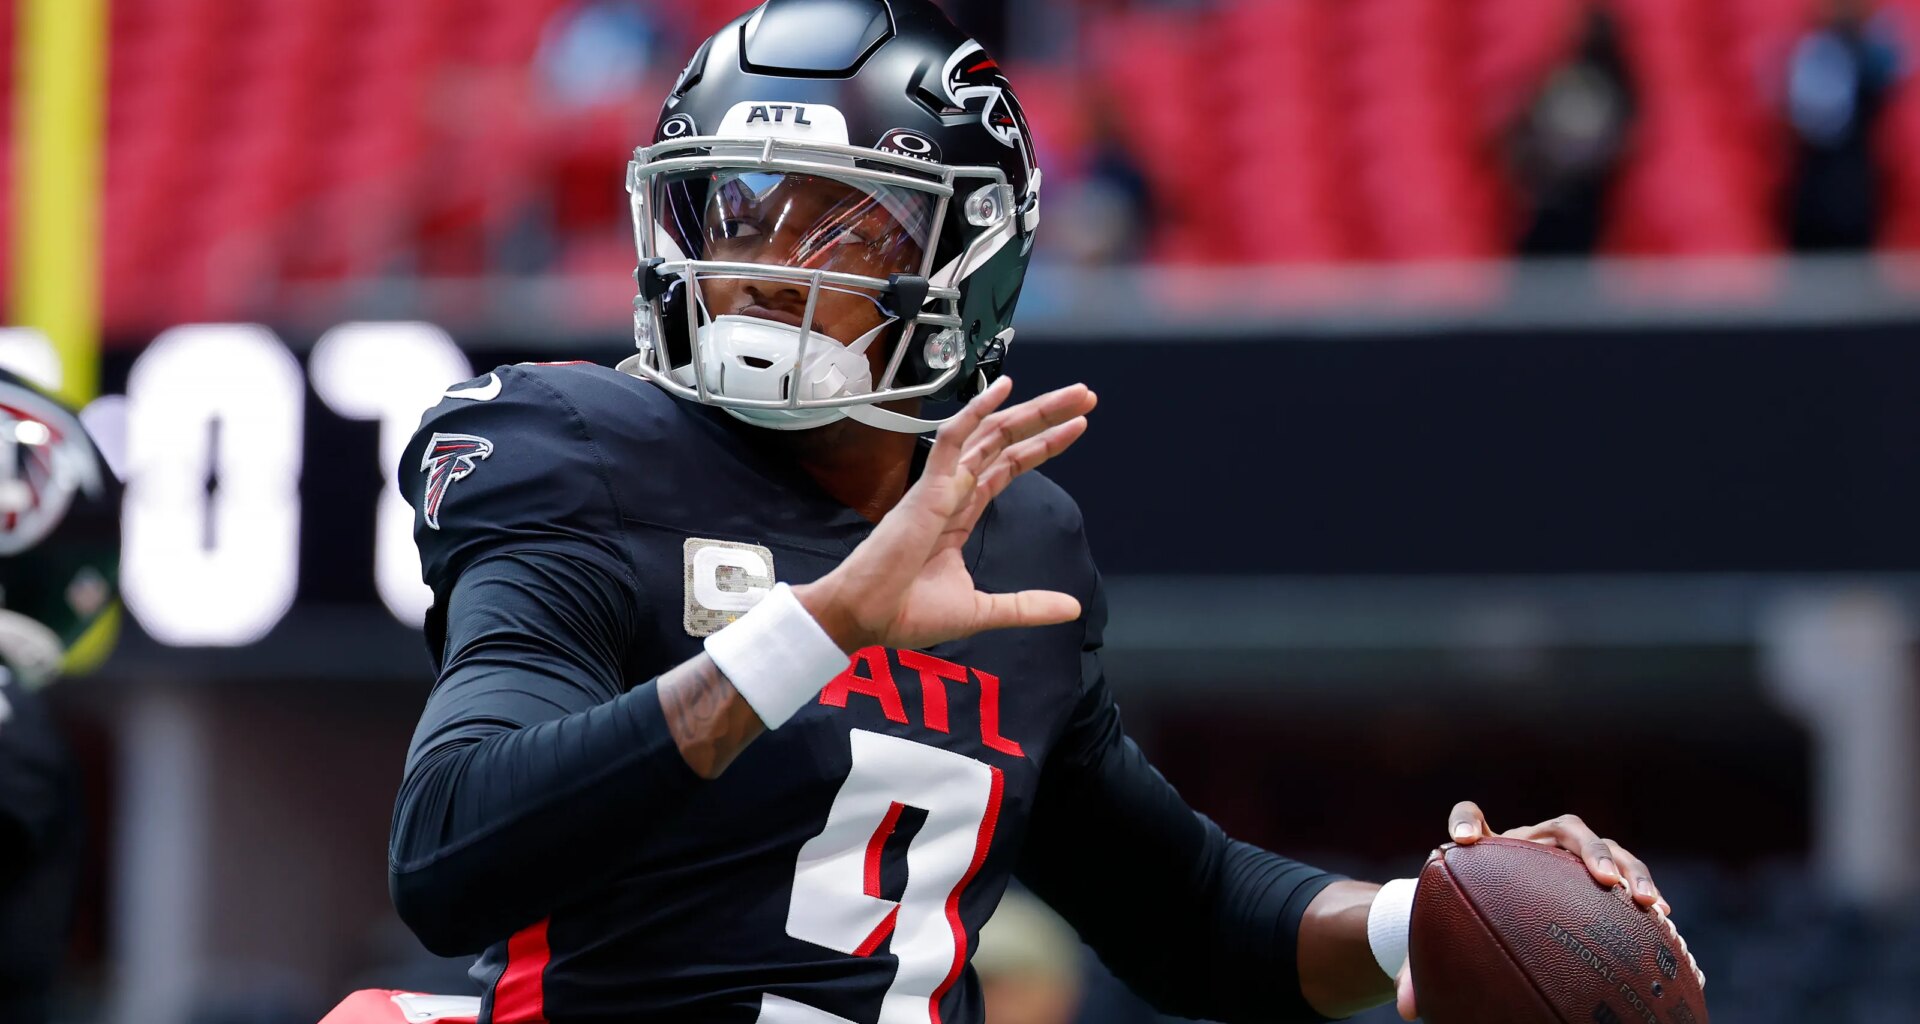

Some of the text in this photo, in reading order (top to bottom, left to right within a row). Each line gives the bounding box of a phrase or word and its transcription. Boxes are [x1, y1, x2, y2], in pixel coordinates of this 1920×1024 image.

[745, 104, 812, 127] ATL
[692, 545, 774, 612] C
[818, 645, 1025, 757] ATL
[755, 728, 1004, 1024] 9
[1548, 923, 1616, 984] NATIONAL
